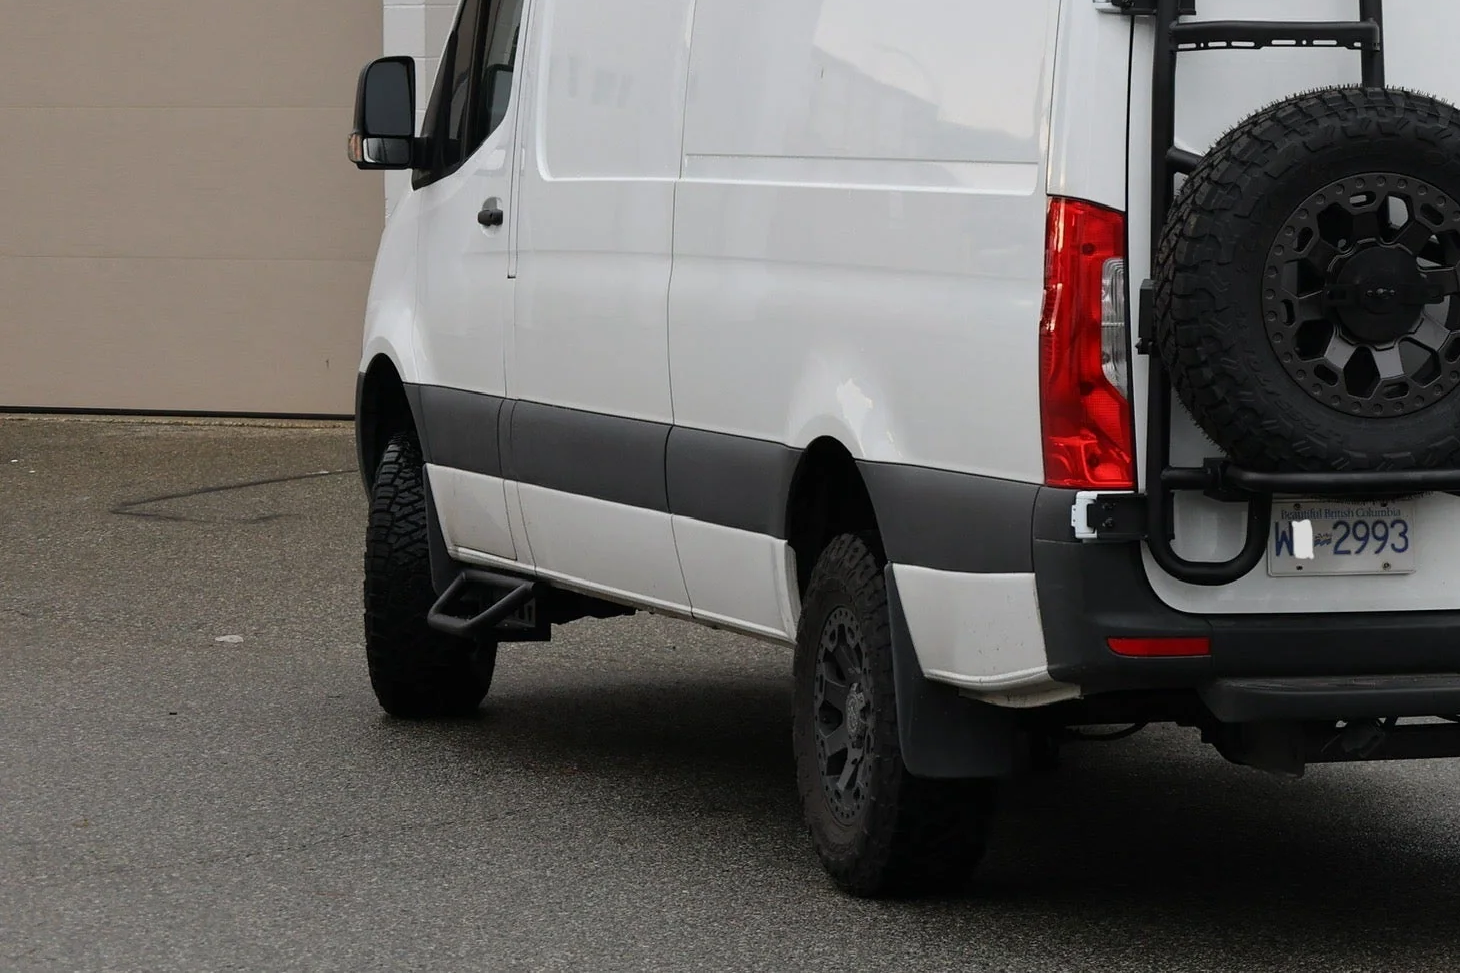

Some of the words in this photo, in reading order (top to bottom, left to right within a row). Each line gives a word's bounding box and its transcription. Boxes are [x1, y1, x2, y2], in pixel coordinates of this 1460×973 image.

[1281, 508, 1322, 520] Beautiful
[1325, 508, 1354, 519] British
[1356, 507, 1401, 518] Columbia
[1332, 518, 1410, 556] 2993
